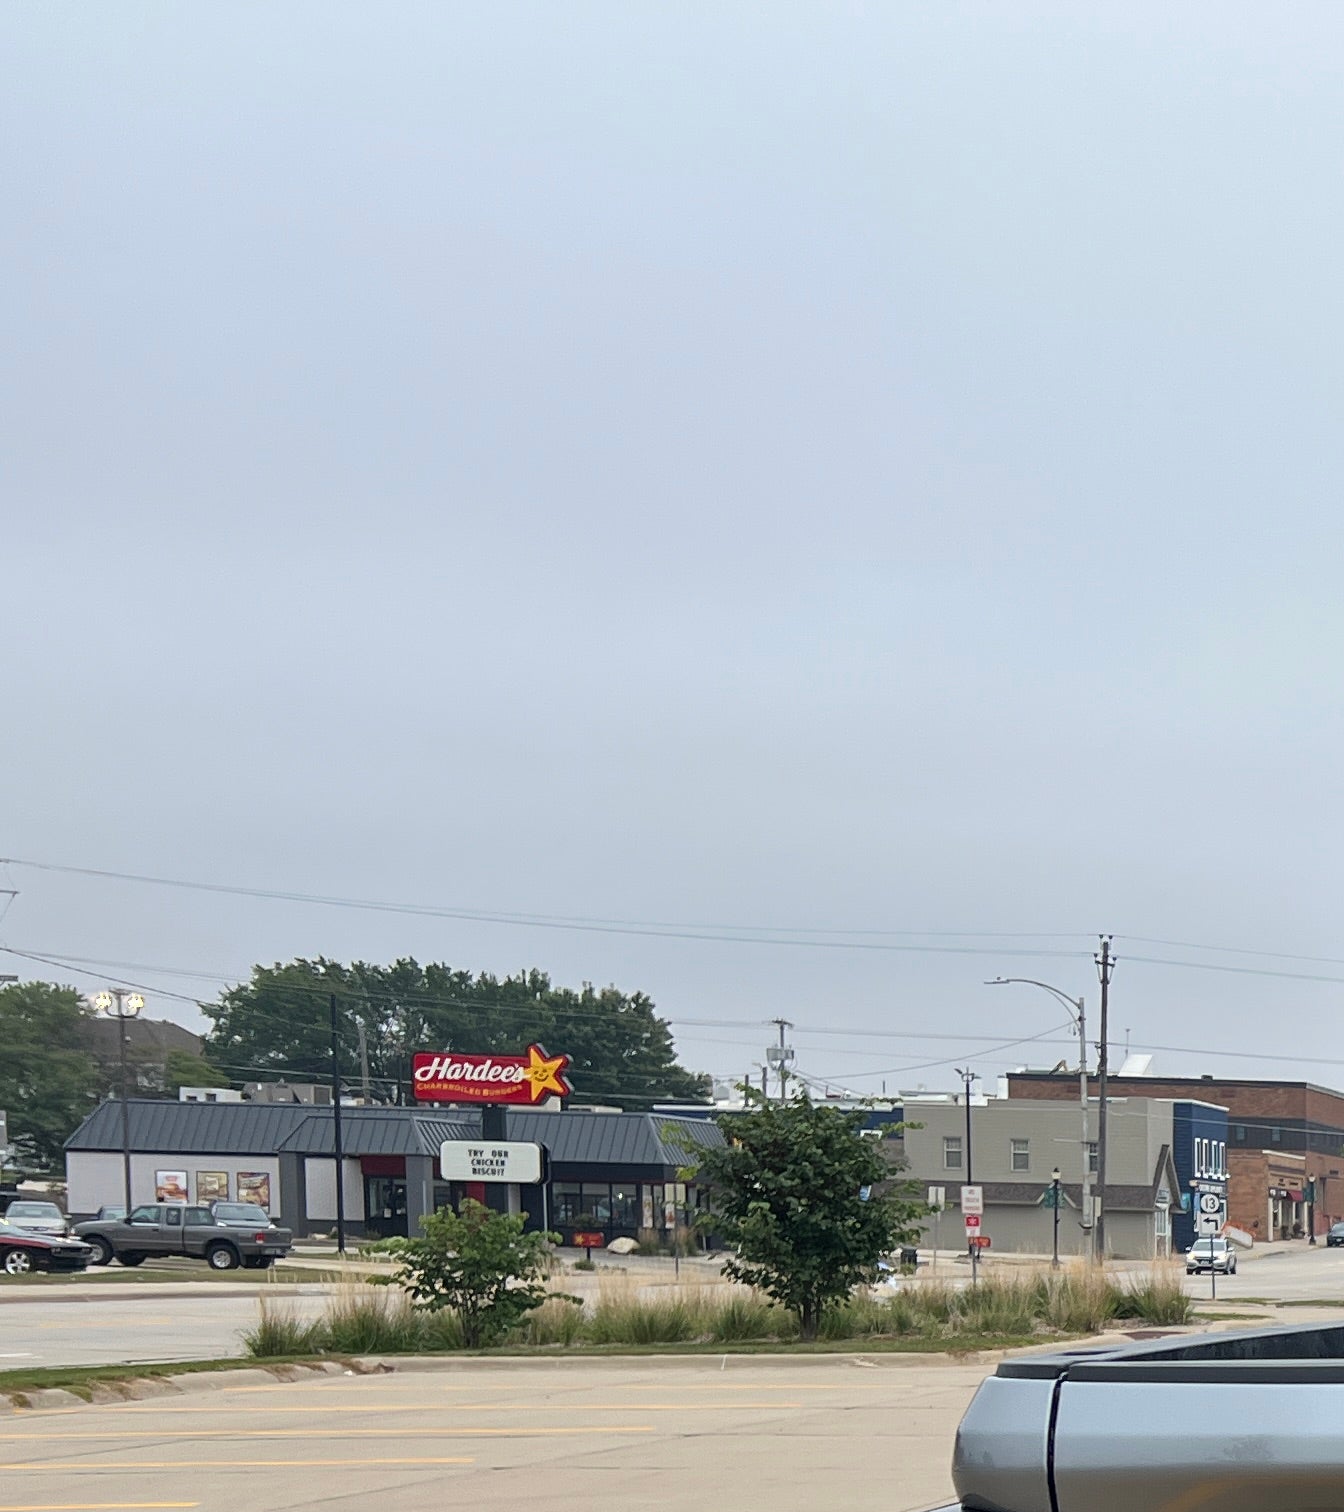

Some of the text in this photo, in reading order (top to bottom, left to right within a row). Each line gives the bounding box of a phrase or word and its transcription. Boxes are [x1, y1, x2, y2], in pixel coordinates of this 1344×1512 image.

[415, 1057, 527, 1083] Hardee's
[467, 1149, 484, 1157] TRY
[471, 1158, 506, 1167] CHICKEN
[1204, 1197, 1216, 1210] 13
